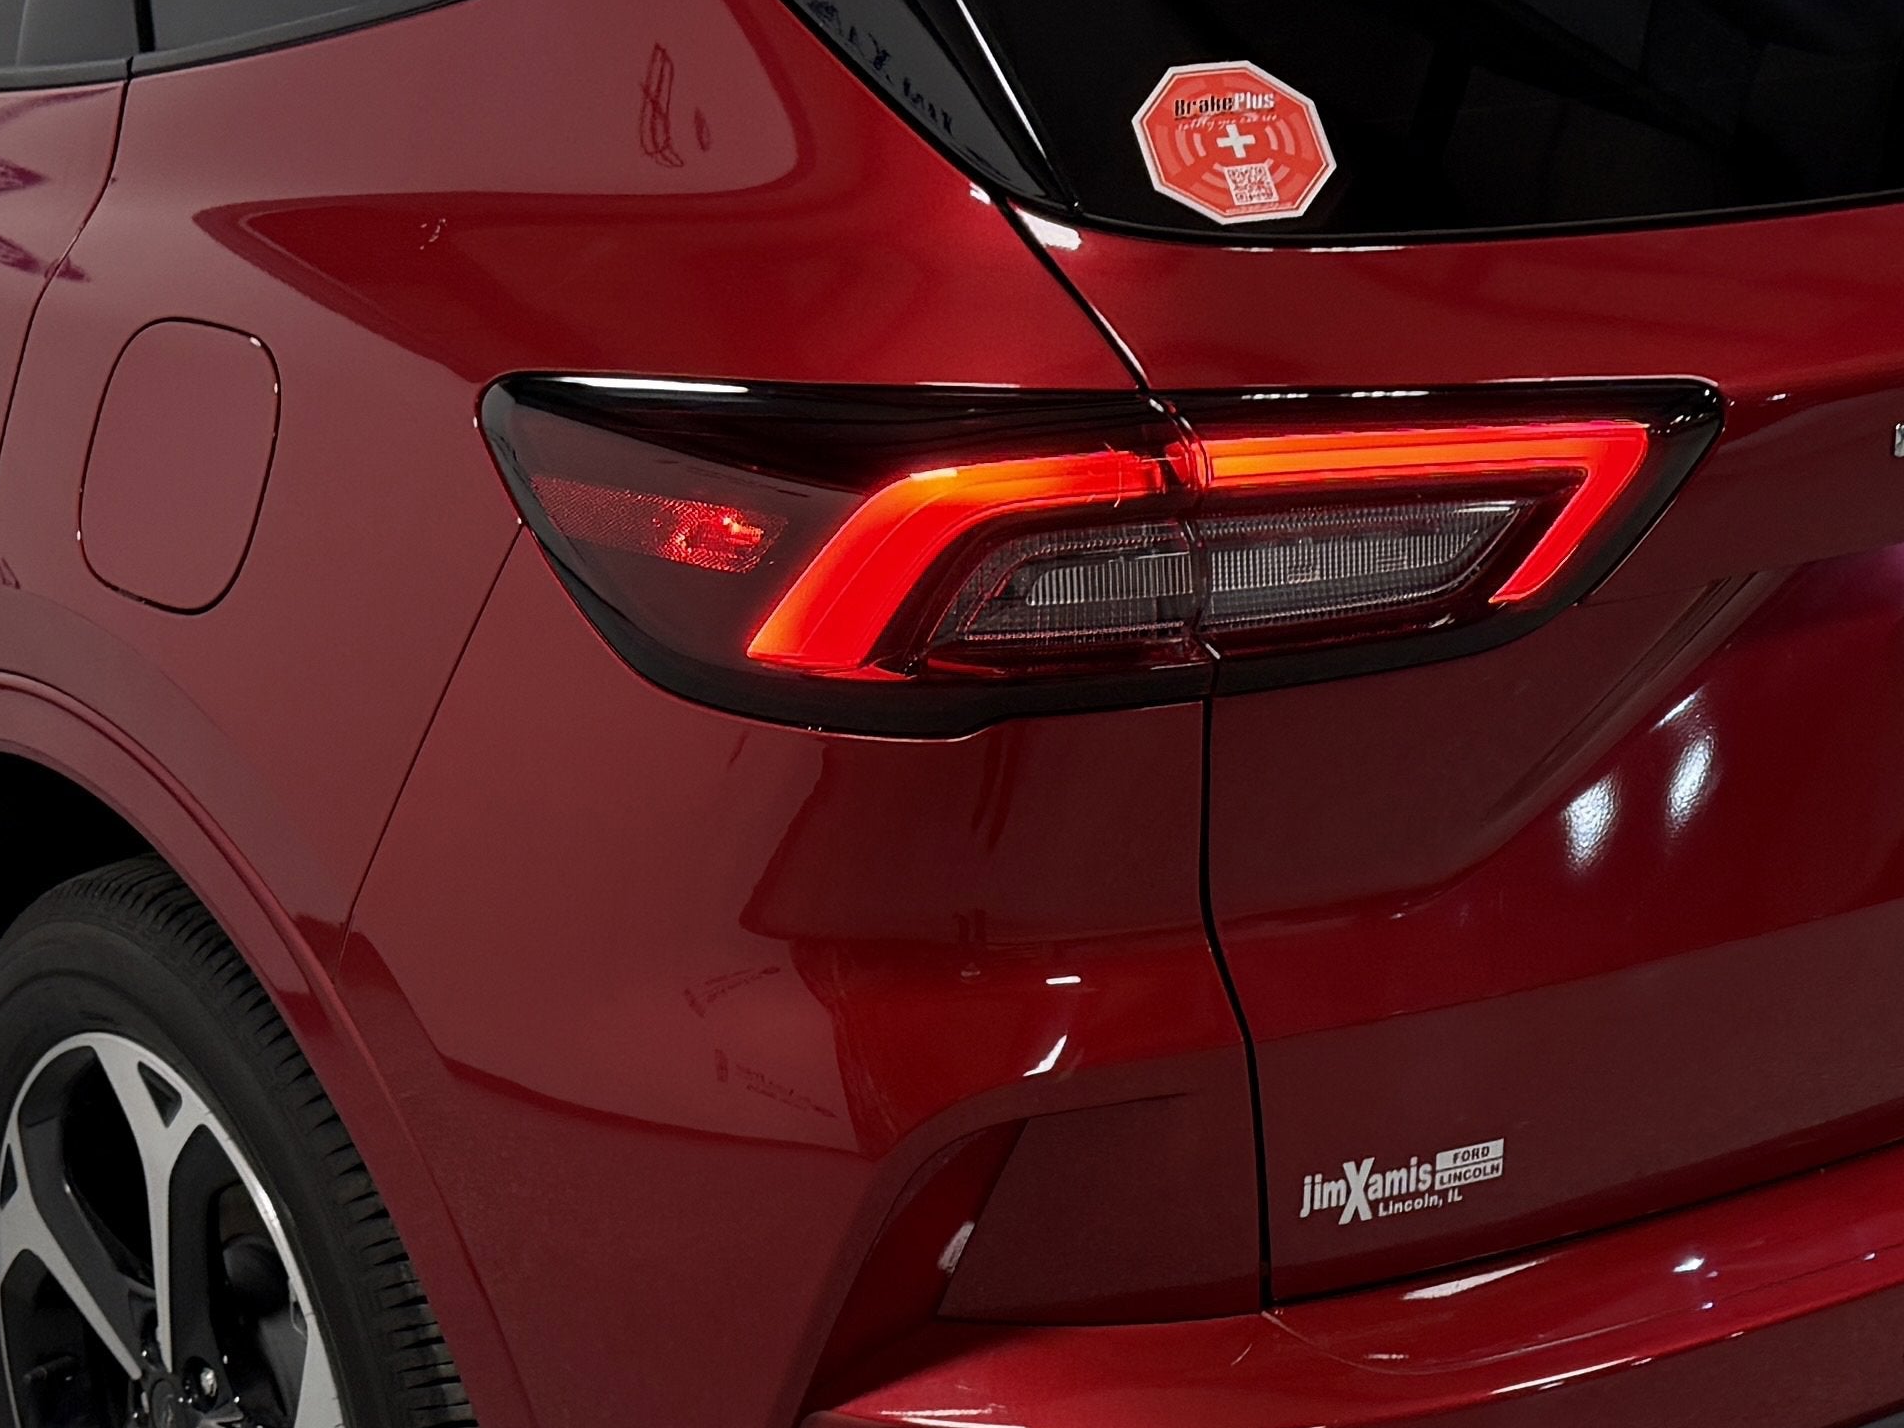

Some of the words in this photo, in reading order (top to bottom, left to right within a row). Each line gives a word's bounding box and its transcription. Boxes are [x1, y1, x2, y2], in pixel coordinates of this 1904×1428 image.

[1452, 1145, 1491, 1164] FORD
[1438, 1163, 1501, 1187] LINCOLN
[1378, 1191, 1443, 1217] Lincoln,
[1447, 1187, 1463, 1204] IL
